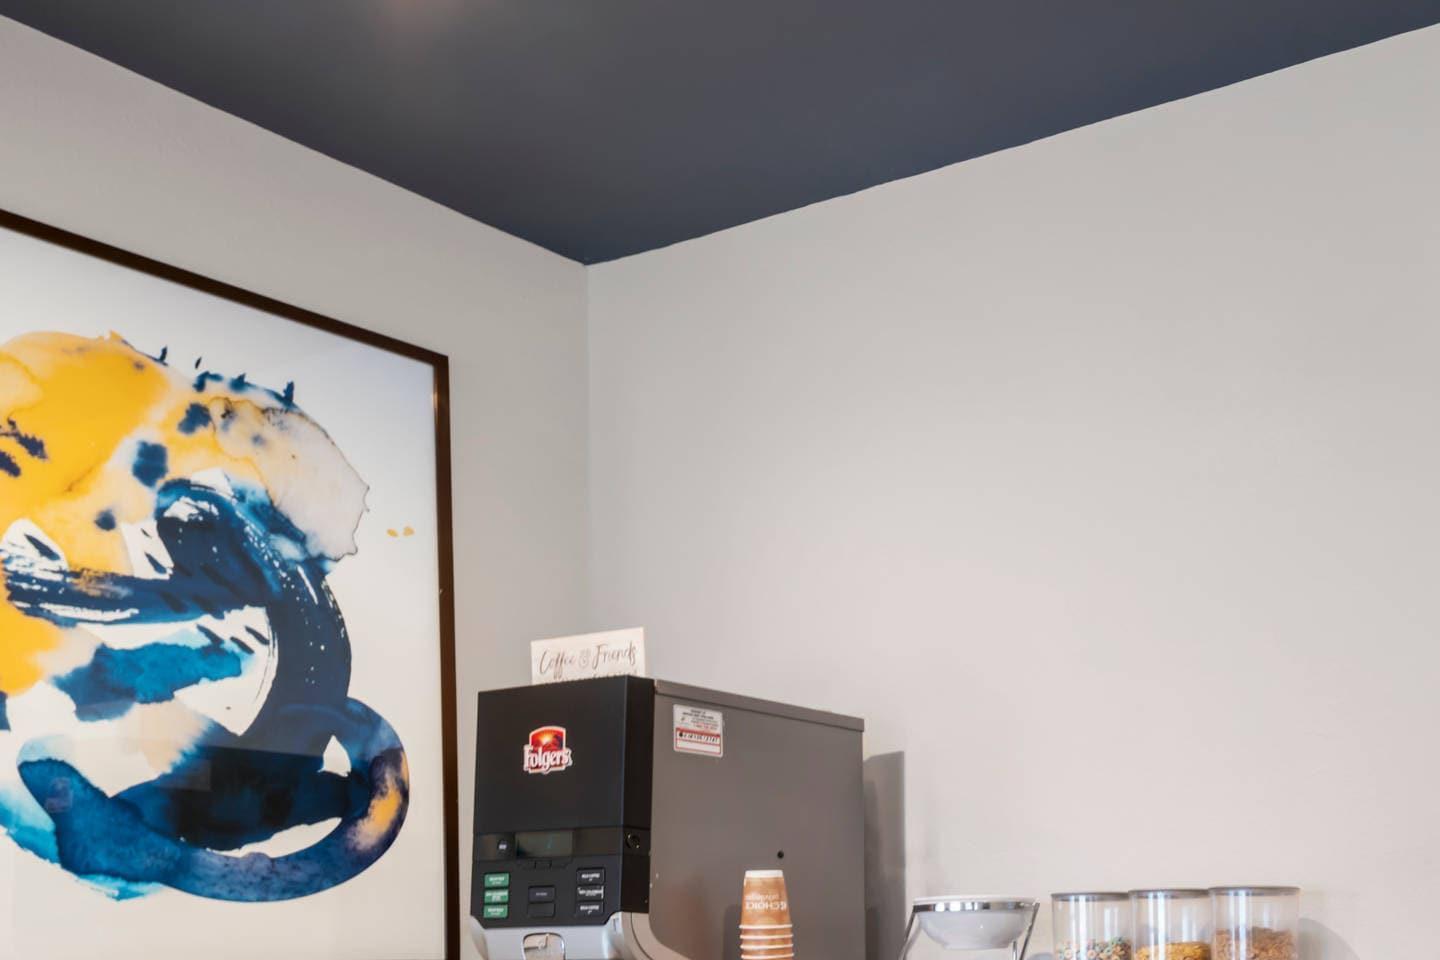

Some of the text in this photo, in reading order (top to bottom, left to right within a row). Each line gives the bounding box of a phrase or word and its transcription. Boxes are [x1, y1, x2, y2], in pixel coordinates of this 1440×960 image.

[539, 641, 637, 676] Coffee Friends
[524, 745, 571, 773] Folgers
